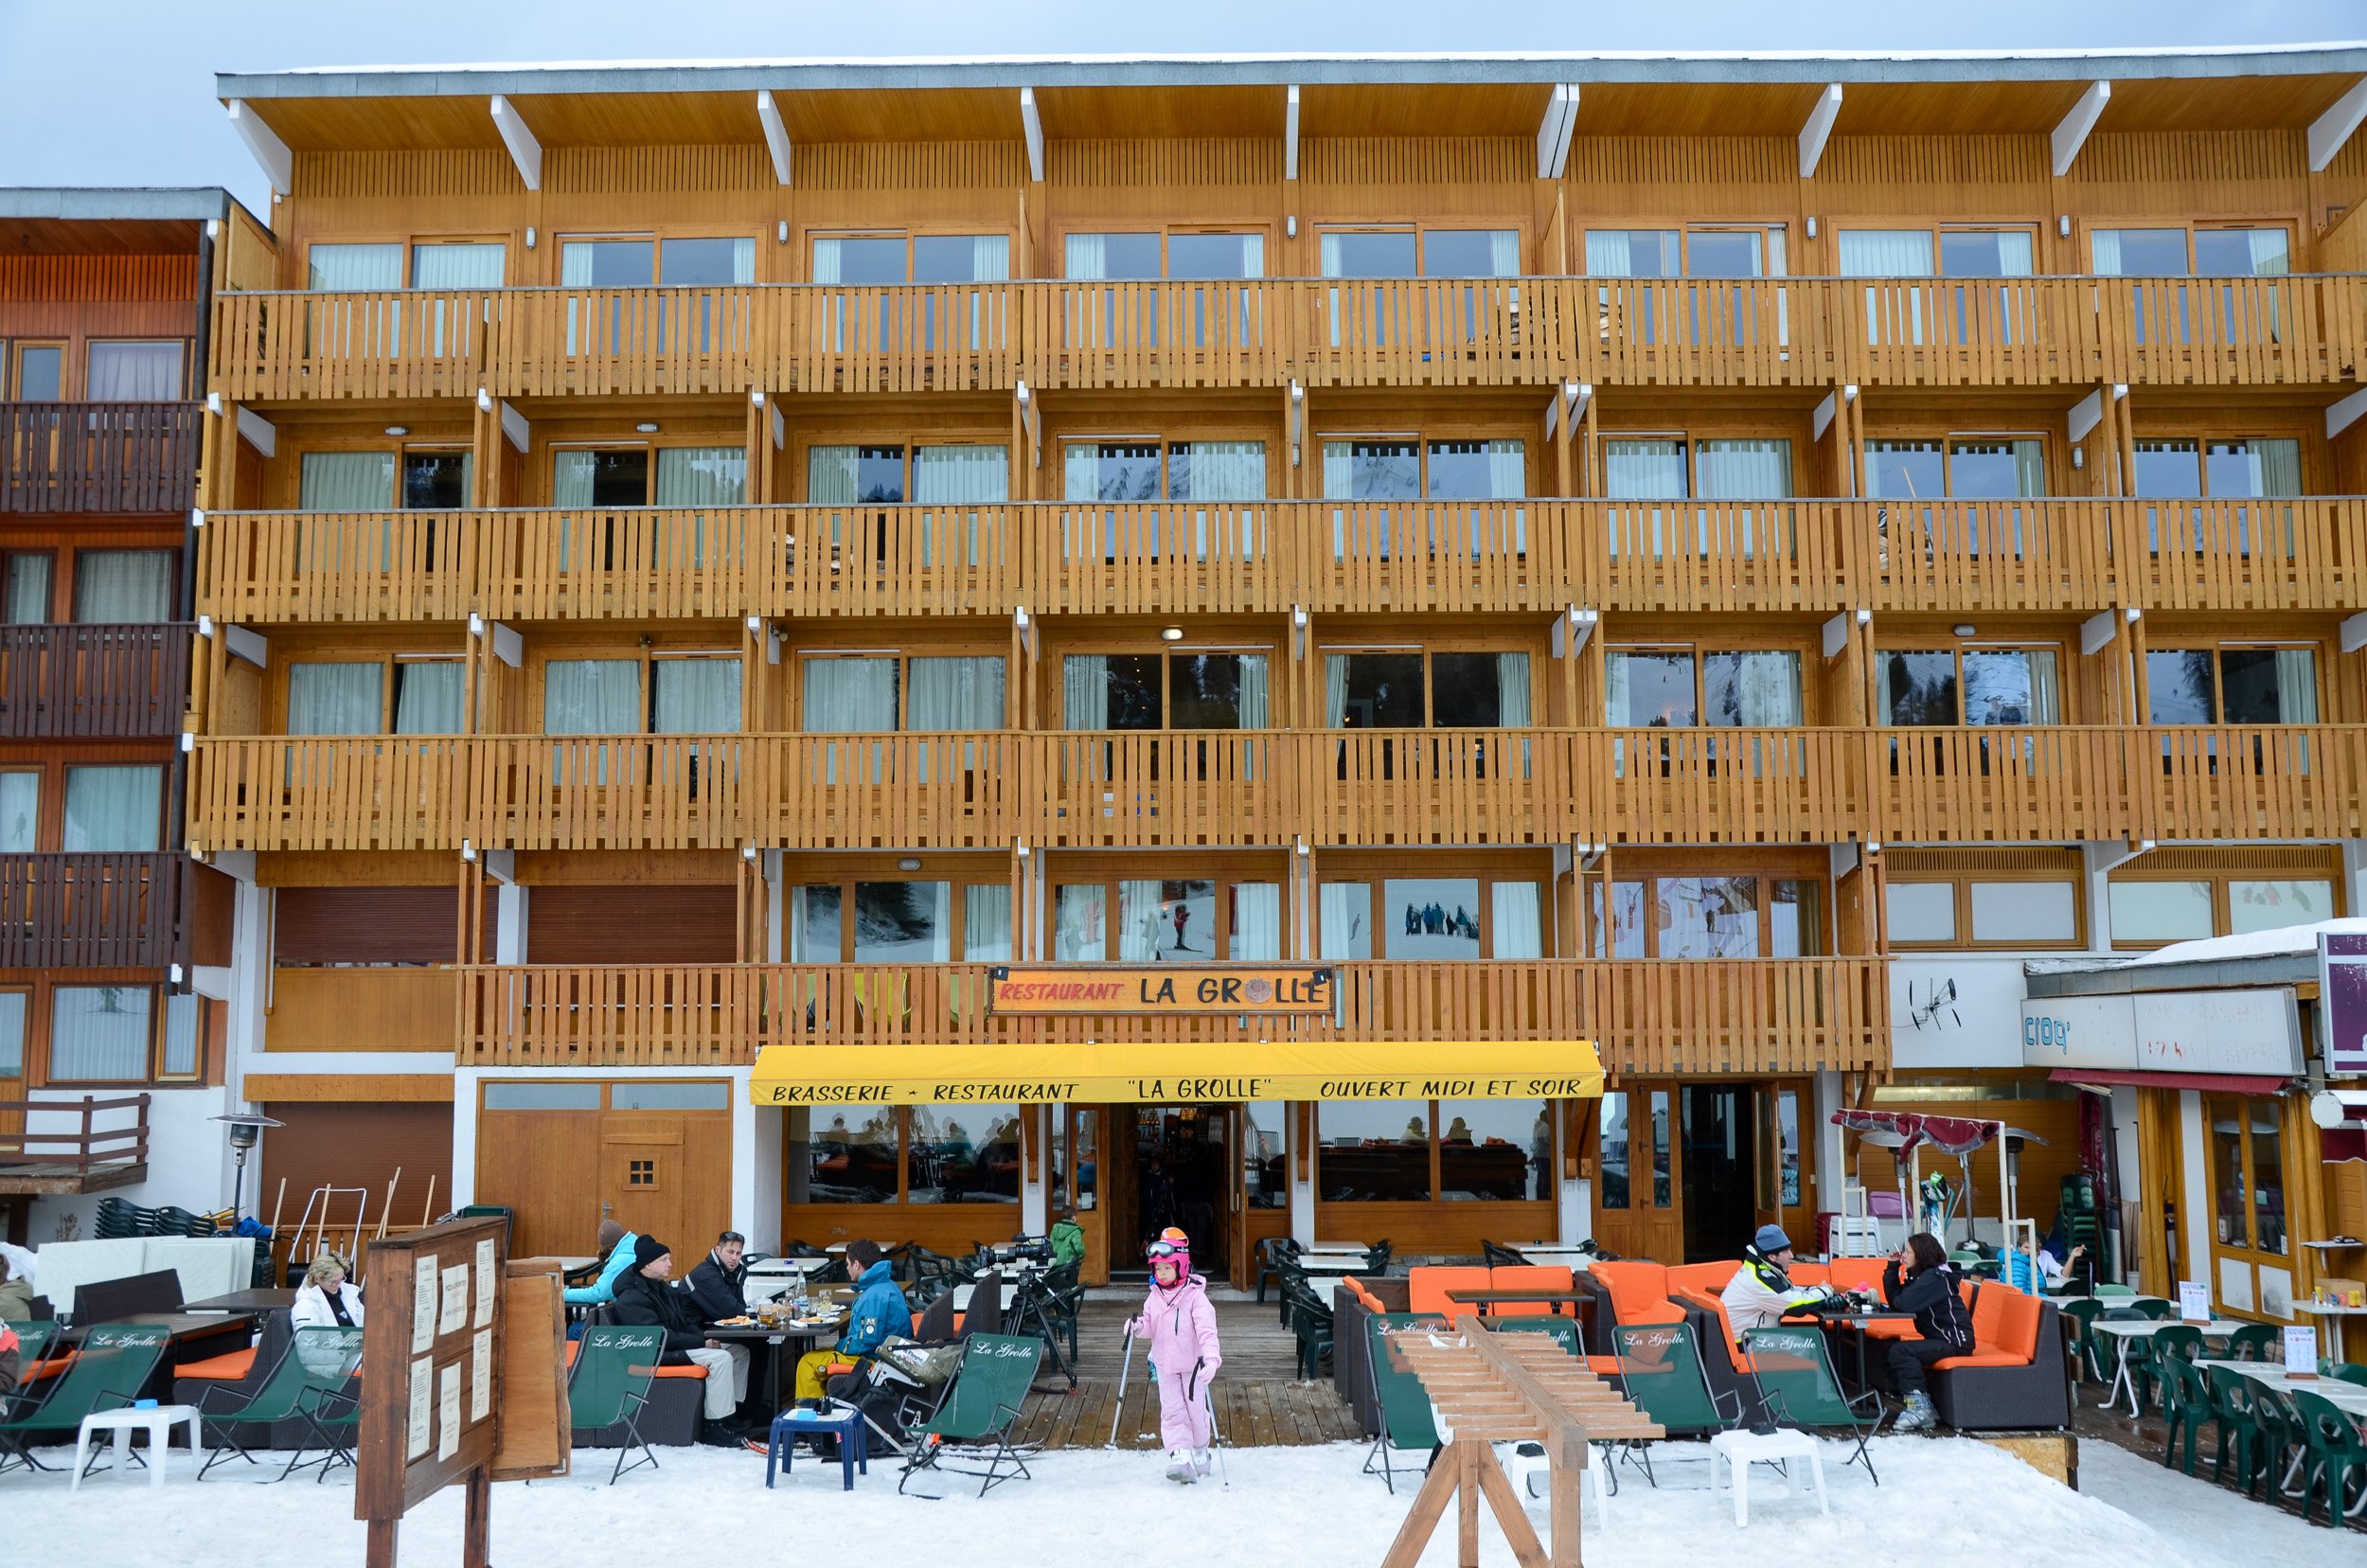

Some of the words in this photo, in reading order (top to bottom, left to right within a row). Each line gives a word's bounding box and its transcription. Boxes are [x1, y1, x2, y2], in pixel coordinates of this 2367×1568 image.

[1000, 983, 1125, 1001] RESTAURANT
[1140, 977, 1177, 1004] LA
[773, 1085, 894, 1101] BRASSERIE
[934, 1083, 1079, 1100] RESTAURANT
[1320, 1080, 1411, 1097] OUVERT
[1421, 1079, 1474, 1096] MIDI
[1486, 1080, 1517, 1096] ET
[1526, 1079, 1581, 1096] SOIR
[1378, 1321, 1396, 1336] La
[92, 1332, 114, 1346] La
[116, 1332, 156, 1348] Grolle
[592, 1333, 612, 1347] La
[614, 1334, 653, 1350] Grolle
[1625, 1332, 1644, 1346] La
[1647, 1332, 1684, 1347] Grolle
[1755, 1334, 1775, 1349] La
[1779, 1335, 1816, 1350] Grolle
[972, 1341, 992, 1355] La
[995, 1343, 1032, 1358] Grolle
